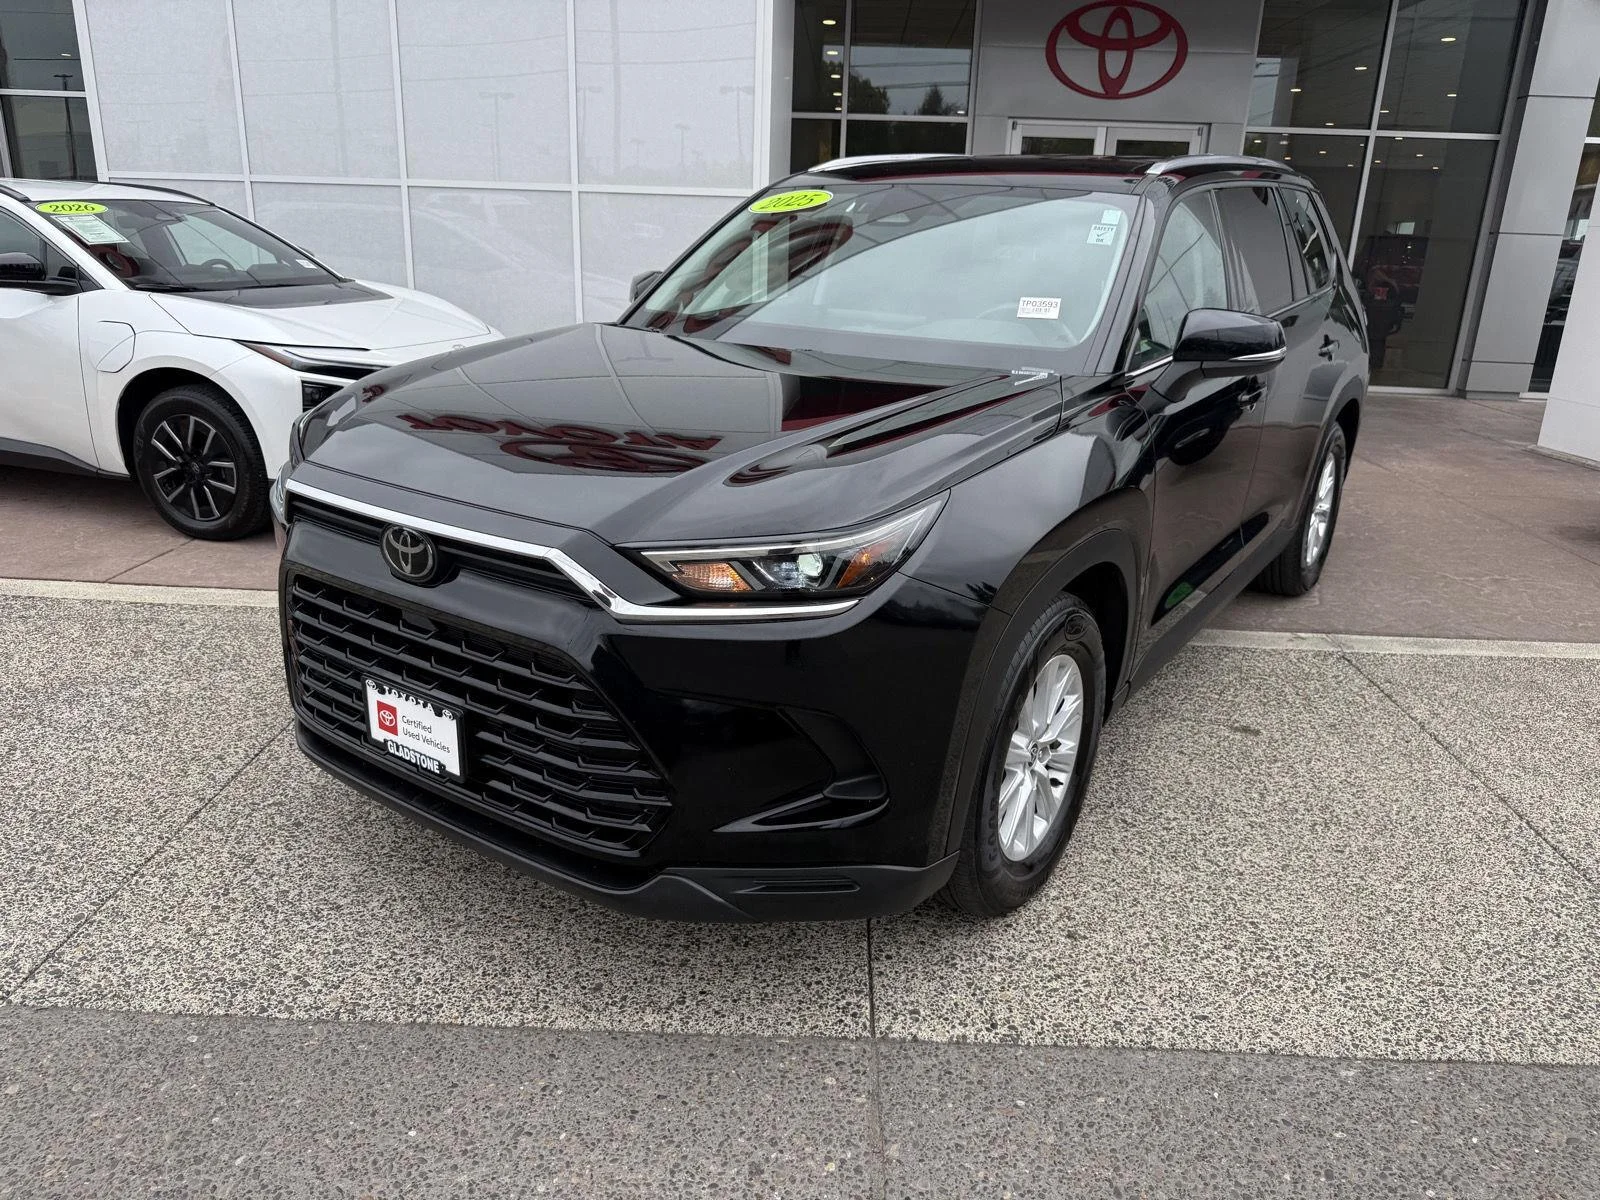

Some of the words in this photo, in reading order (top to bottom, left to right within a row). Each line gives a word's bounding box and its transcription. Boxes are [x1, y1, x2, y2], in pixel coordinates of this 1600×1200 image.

[49, 203, 95, 212] 2026
[758, 193, 822, 210] 2025
[383, 685, 433, 712] TOYOTA
[401, 715, 432, 734] Certified
[402, 727, 421, 741] Used
[421, 734, 451, 754] Vehicles
[387, 740, 441, 774] GLADSTONE
